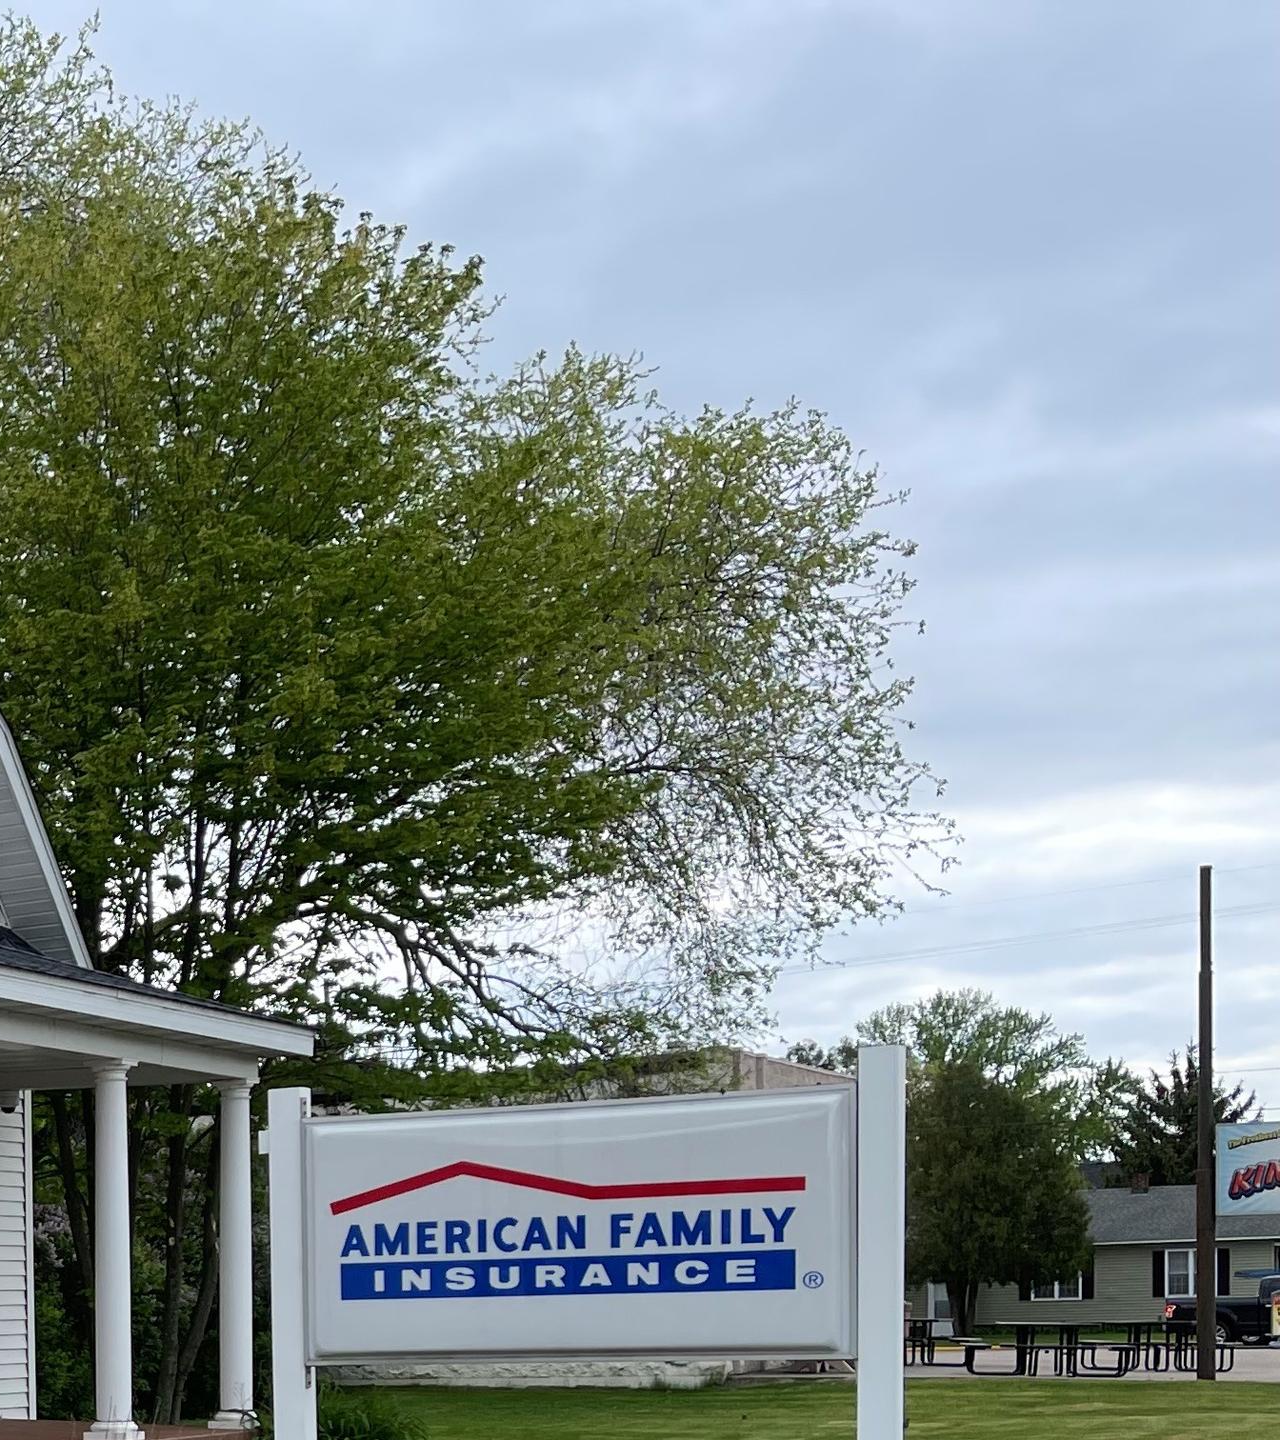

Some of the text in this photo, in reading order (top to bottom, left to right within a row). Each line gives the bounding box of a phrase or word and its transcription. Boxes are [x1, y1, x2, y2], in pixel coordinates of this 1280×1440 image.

[340, 1207, 796, 1258] AMERICAN FAMILY
[373, 1259, 757, 1293] INSURANCE
